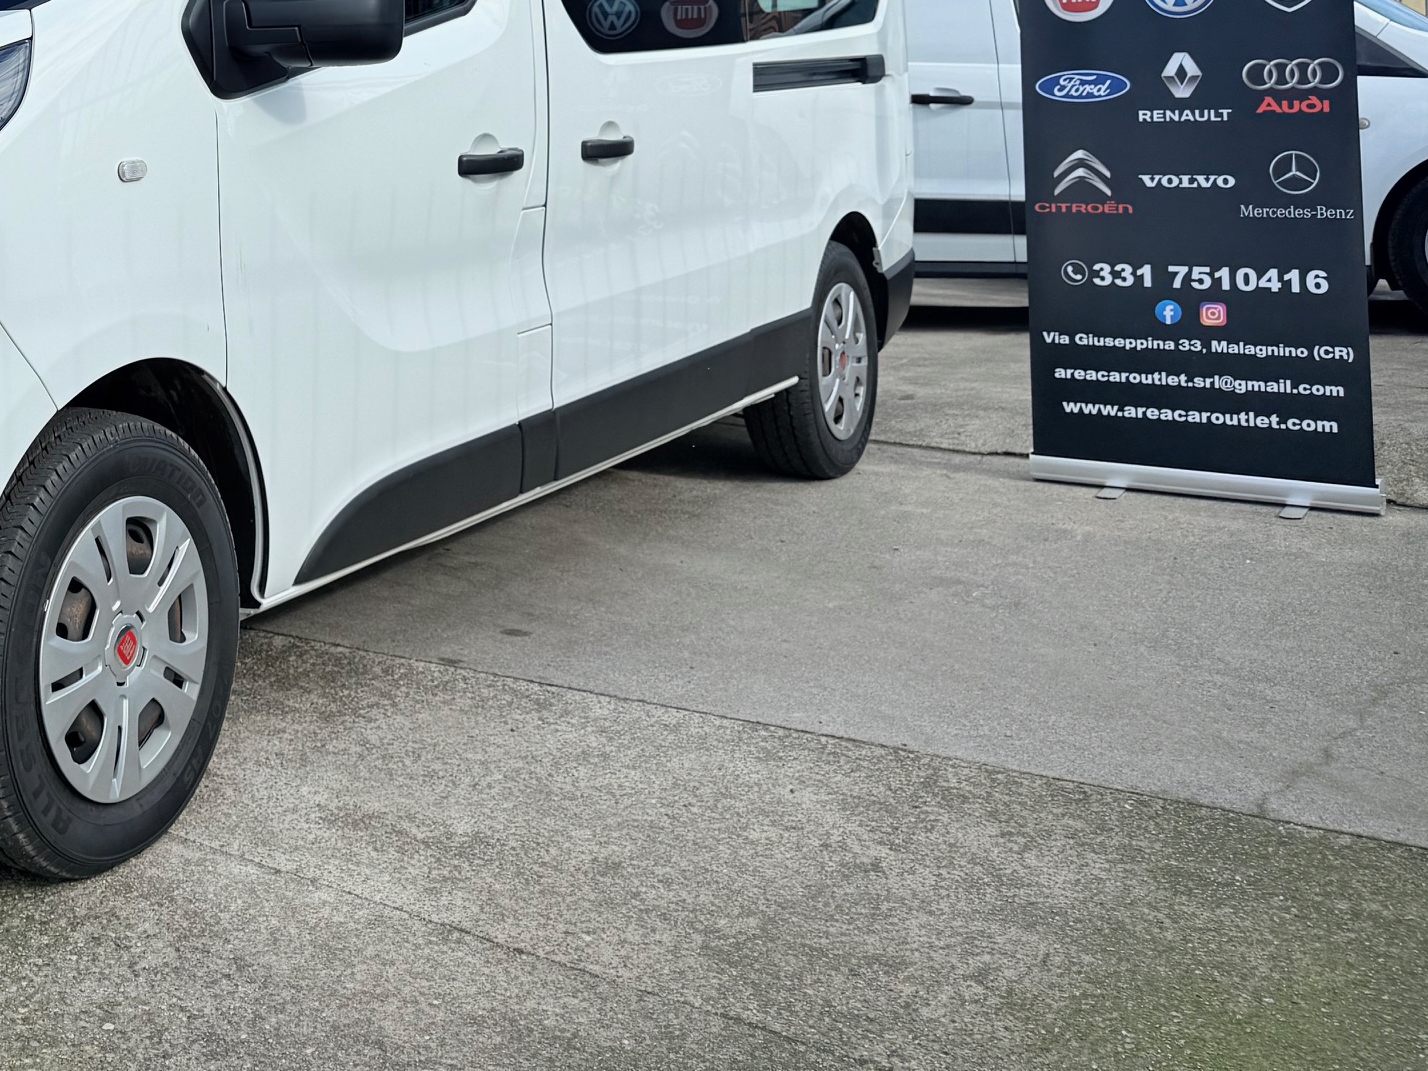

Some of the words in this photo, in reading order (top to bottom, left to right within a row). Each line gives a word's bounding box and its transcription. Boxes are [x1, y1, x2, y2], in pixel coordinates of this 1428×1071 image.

[1053, 74, 1111, 97] Ford
[1138, 109, 1232, 122] RENAULT
[1138, 174, 1236, 188] VOLVO
[1239, 204, 1355, 220] Mercedes-Benz
[1092, 263, 1153, 288] 331
[1167, 265, 1329, 294] 7510416
[1042, 331, 1070, 345] Via
[1074, 333, 1174, 353] Giuseppina
[1178, 339, 1207, 354] 33,
[1211, 340, 1308, 361] Malagnino
[1313, 346, 1354, 363] (CR)
[1054, 365, 1345, 398] areacaroutlet.srl@gmail.com
[1062, 400, 1339, 434] www.areacaroutlet.com
